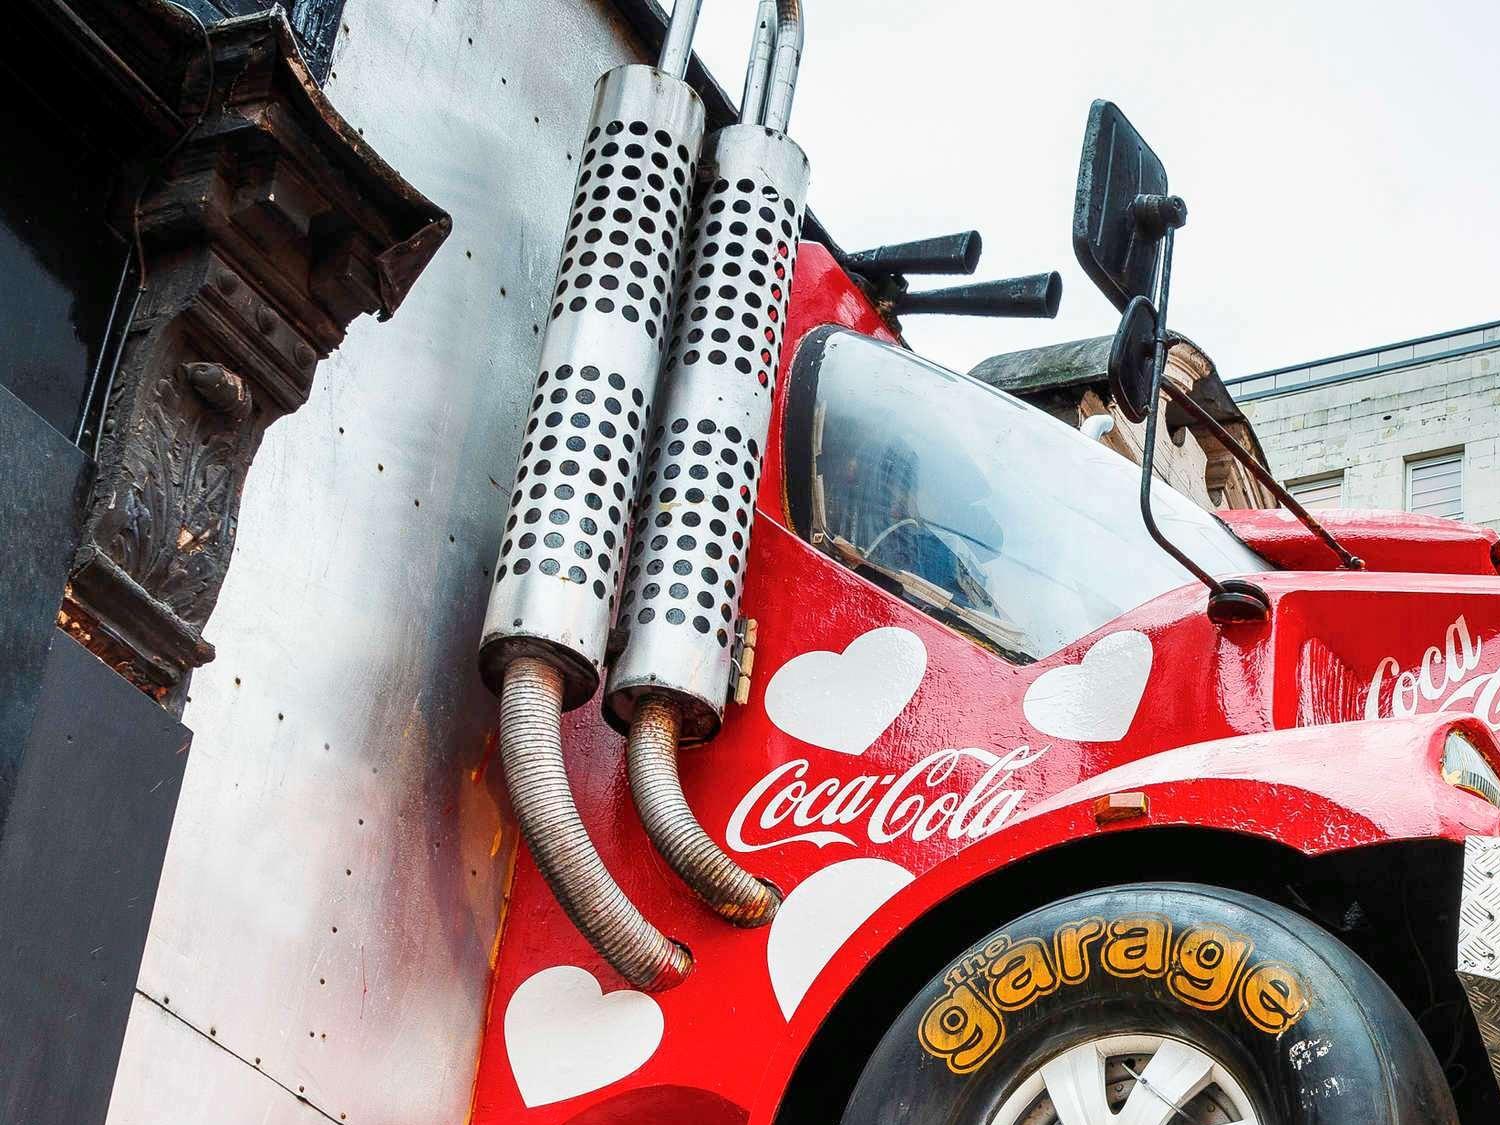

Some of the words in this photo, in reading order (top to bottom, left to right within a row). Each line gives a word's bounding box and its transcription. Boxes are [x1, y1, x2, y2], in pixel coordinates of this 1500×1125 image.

[725, 743, 1053, 853] Coca-Cola
[917, 912, 1313, 1074] garage
[944, 934, 1011, 990] the
